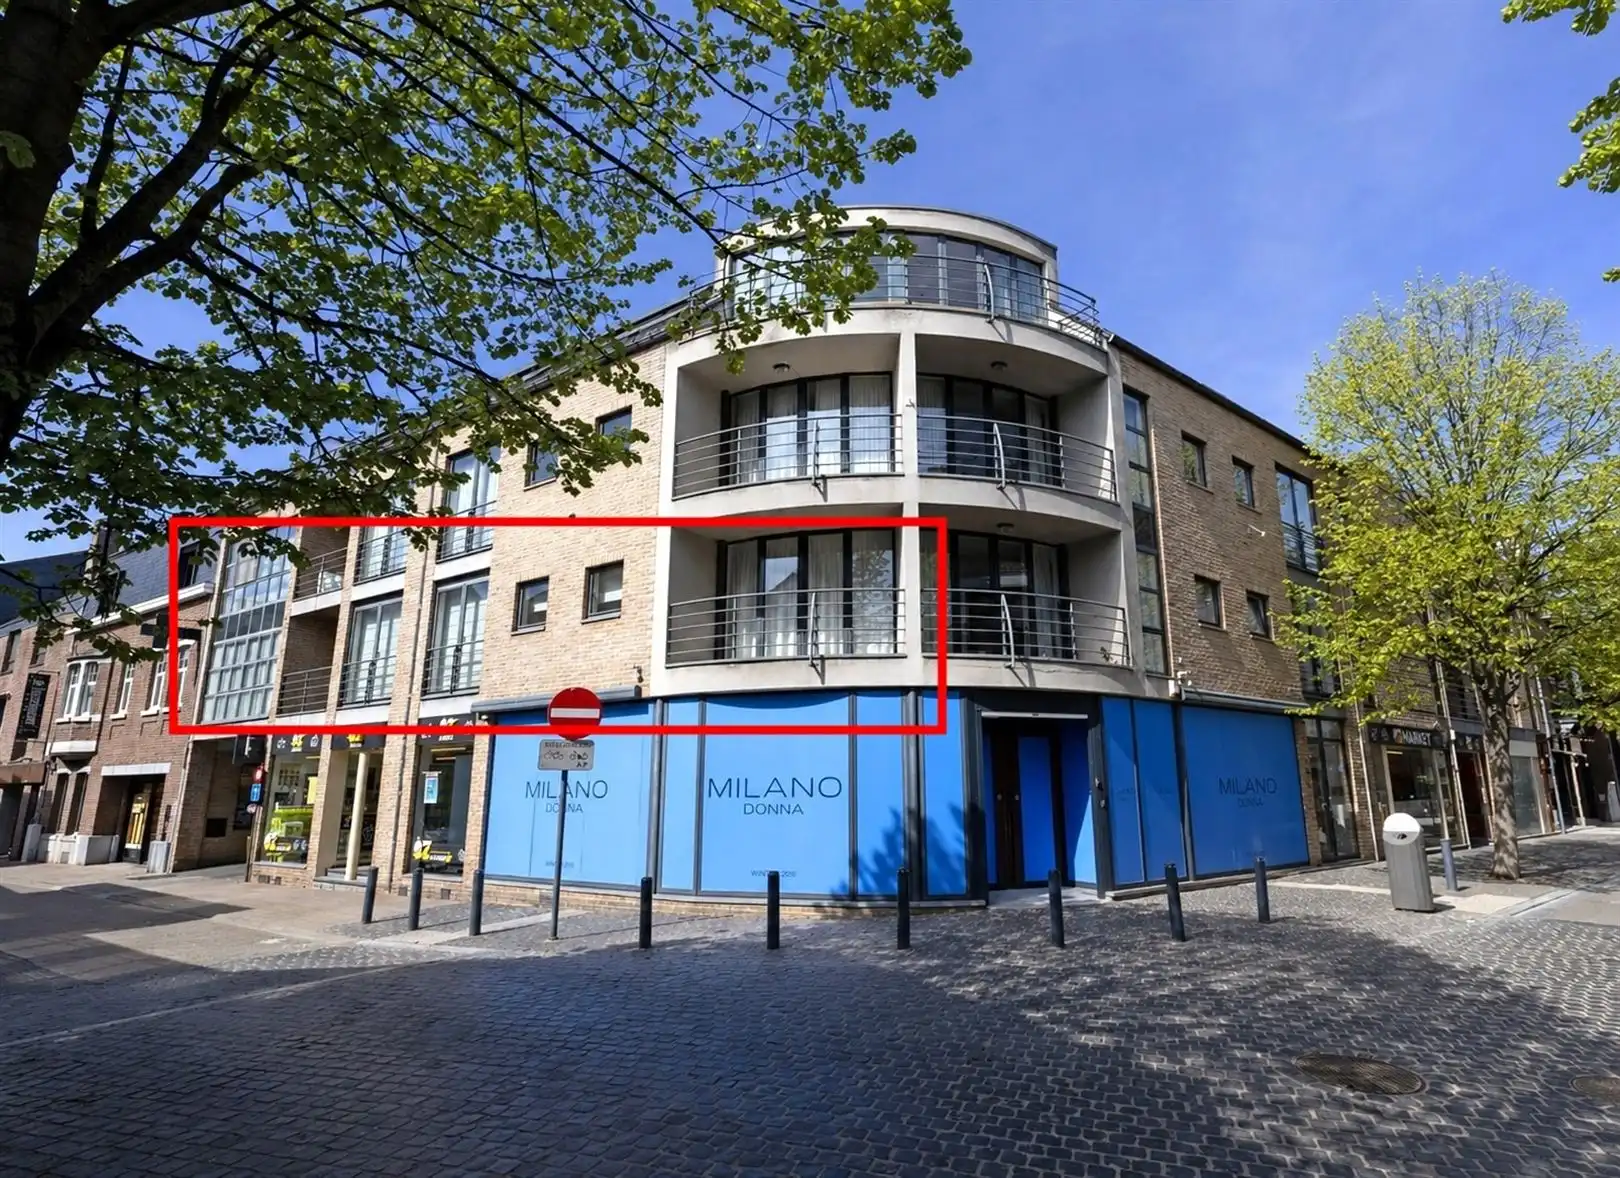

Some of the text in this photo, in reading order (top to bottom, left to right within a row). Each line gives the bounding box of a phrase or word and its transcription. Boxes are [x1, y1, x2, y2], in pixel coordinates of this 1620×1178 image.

[525, 780, 608, 799] MILANO
[708, 776, 842, 798] MILANO
[1218, 776, 1278, 795] MILANO
[545, 802, 584, 813] DONA
[743, 803, 804, 815] DONNA
